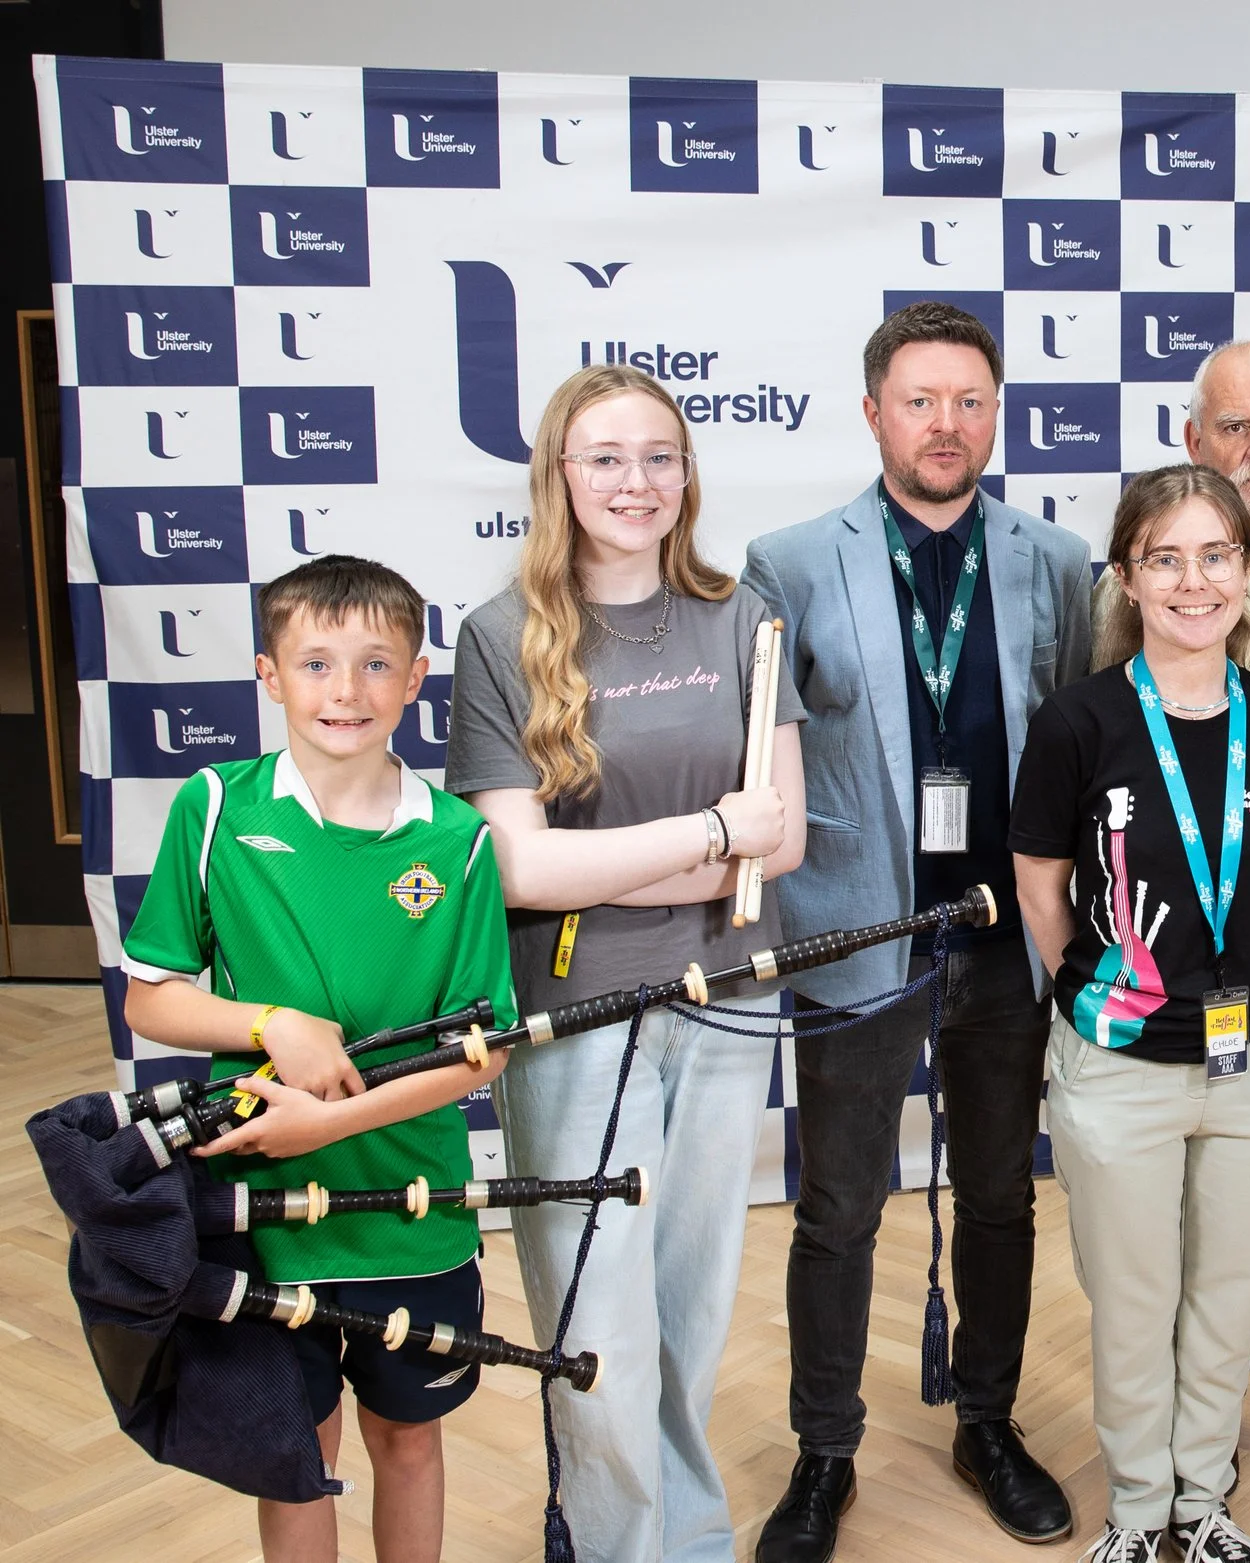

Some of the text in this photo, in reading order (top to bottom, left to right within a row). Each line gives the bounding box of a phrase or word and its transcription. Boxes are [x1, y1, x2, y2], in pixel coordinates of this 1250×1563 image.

[145, 126, 178, 136] Ulster
[423, 132, 455, 142] Ulster
[146, 136, 202, 149] University
[685, 139, 715, 149] Ulster
[423, 142, 476, 154] University
[935, 145, 964, 154] Ulster
[685, 149, 735, 161] University
[1170, 150, 1197, 159] Ulster
[935, 154, 983, 166] University
[1169, 159, 1216, 170] University
[290, 231, 322, 240] Ulster
[291, 240, 344, 252] University
[1054, 240, 1082, 249] Ulster
[1054, 249, 1100, 260] University
[157, 331, 190, 340] Ulster
[1169, 332, 1196, 341] Ulster
[158, 341, 212, 352] University
[1169, 341, 1214, 352] University
[1054, 424, 1082, 432] Ulster
[299, 430, 331, 440] Ulster
[1054, 432, 1100, 442] University
[299, 440, 352, 451] University
[168, 529, 200, 538] Ulster
[169, 538, 222, 549] University
[604, 683, 638, 698] not
[640, 672, 681, 695] that
[686, 666, 720, 692] deep
[182, 725, 214, 735] Ulster
[183, 734, 236, 744] University
[1218, 1054, 1237, 1066] STAFF
[1221, 1064, 1235, 1074] AAA
